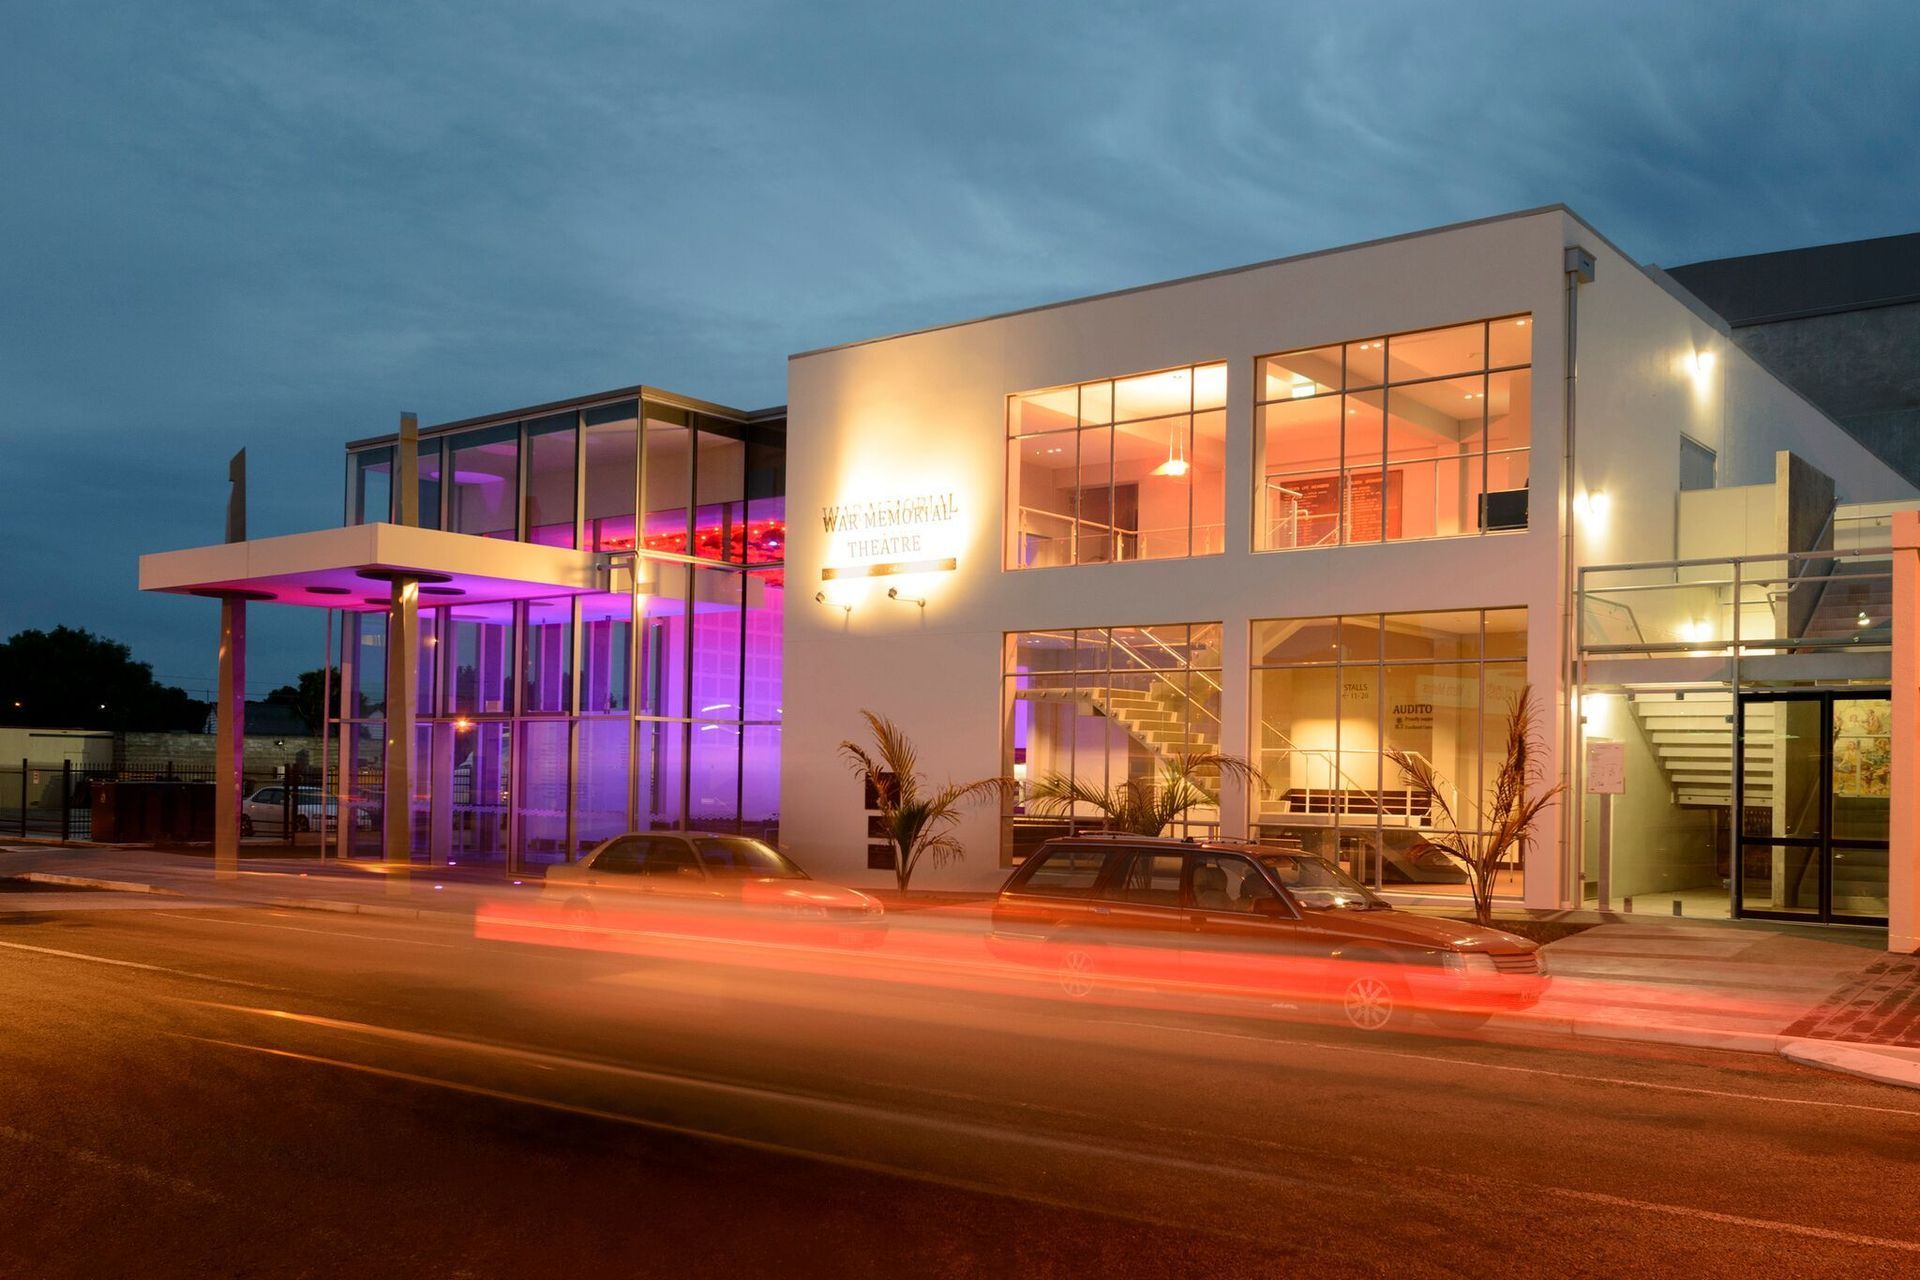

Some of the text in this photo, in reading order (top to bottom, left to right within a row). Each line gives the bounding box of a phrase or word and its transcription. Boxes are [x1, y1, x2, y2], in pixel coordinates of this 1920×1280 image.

[822, 503, 953, 533] WAR MEMORIAL
[847, 535, 921, 558] THEATRE
[1393, 704, 1433, 714] AUDITO
